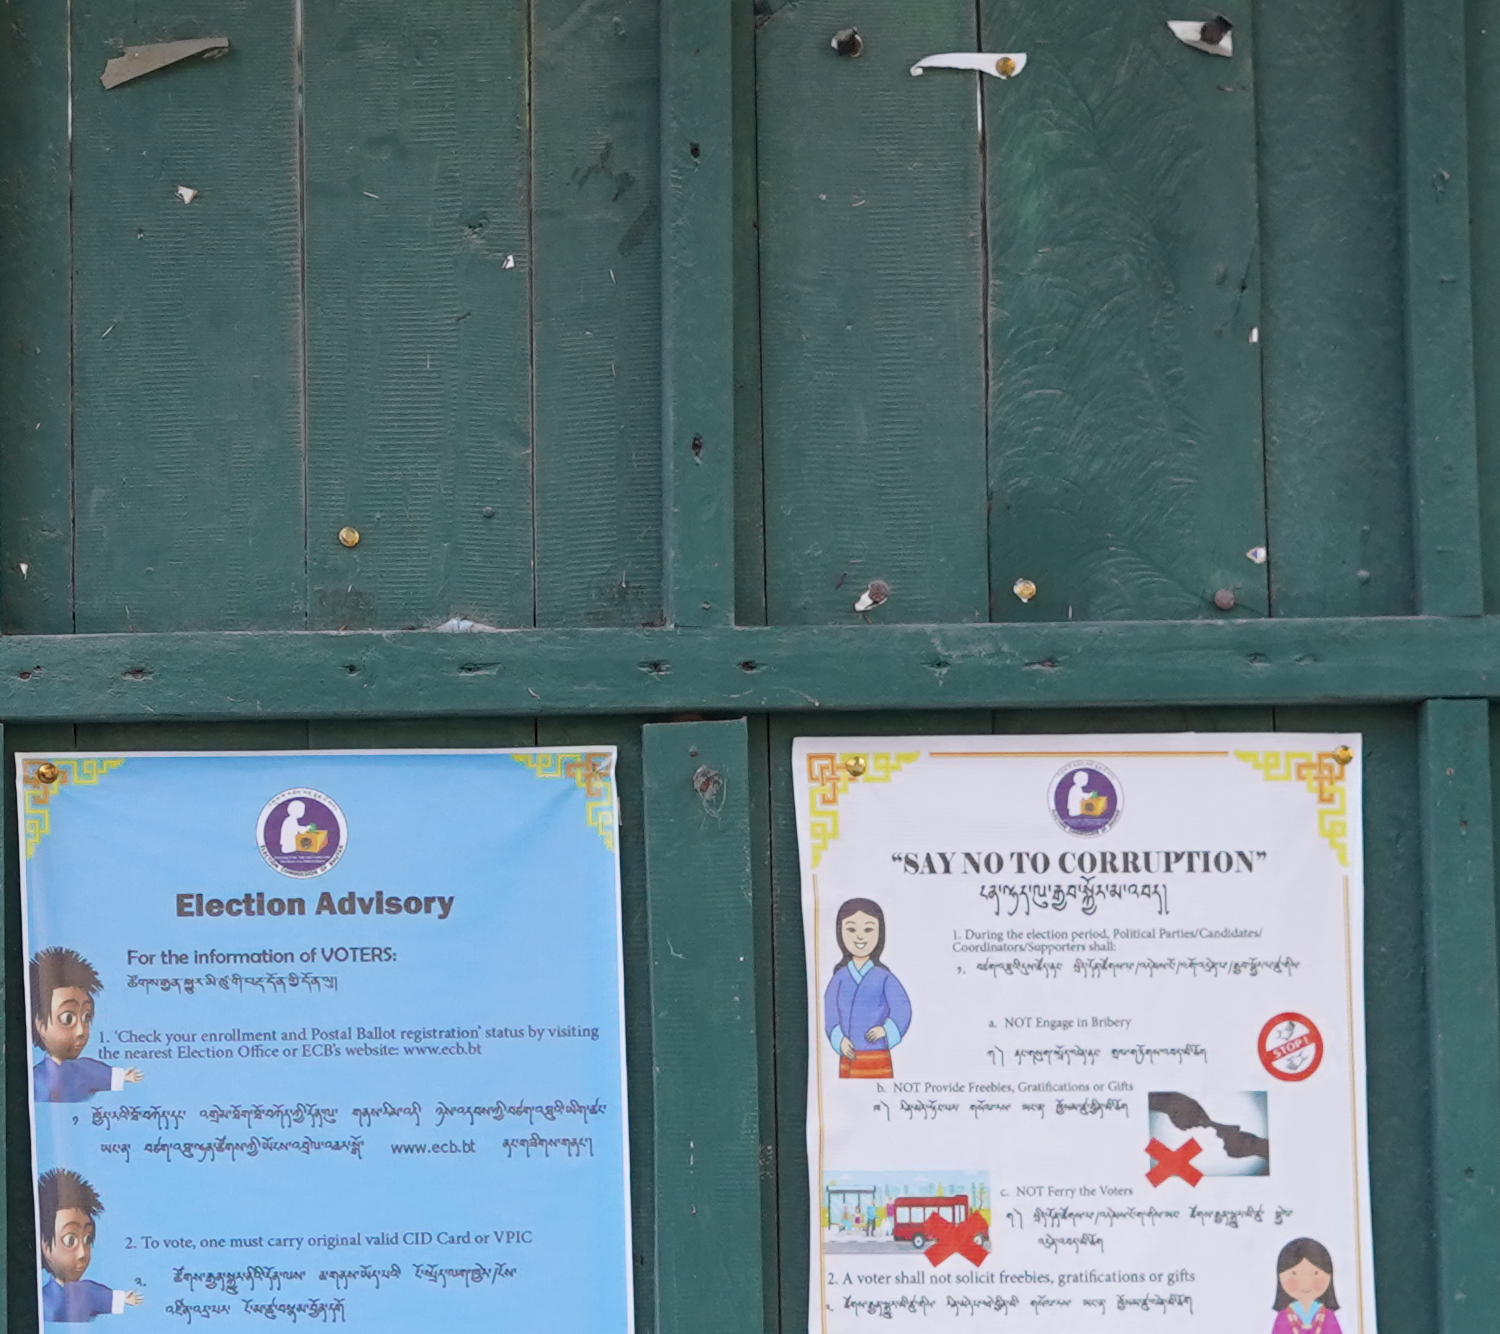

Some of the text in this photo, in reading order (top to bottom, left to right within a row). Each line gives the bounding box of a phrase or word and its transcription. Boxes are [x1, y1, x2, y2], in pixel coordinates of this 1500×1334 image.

[962, 851, 1004, 874] NO
[1009, 851, 1050, 874] TO
[175, 891, 455, 920] Election Advisory
[126, 945, 397, 965] For the information of VOTERS:
[1003, 1016, 1032, 1028] NOT
[1035, 1016, 1074, 1031] Engage
[1076, 1017, 1088, 1028] in
[1090, 1015, 1132, 1030] Bribery
[99, 1030, 110, 1043] 1.
[164, 1032, 197, 1046] your
[200, 1029, 277, 1041] enrollment
[280, 1027, 307, 1045] and
[310, 1026, 352, 1040] Postal
[356, 1025, 396, 1041] Ballot
[484, 1026, 525, 1039] status
[527, 1024, 545, 1042] by
[547, 1024, 599, 1041] visiting
[98, 1045, 120, 1062] the
[123, 1045, 172, 1059] nearest
[176, 1044, 233, 1059] Election
[236, 1043, 279, 1058] Office
[281, 1047, 298, 1058] or
[344, 1042, 399, 1056] website:
[402, 1042, 482, 1056] www.ecb.bt
[390, 1138, 476, 1154] www.ecb.bt
[1015, 1185, 1044, 1197] NOT
[1046, 1185, 1076, 1199] Ferry
[1078, 1184, 1096, 1196] the
[1098, 1184, 1133, 1196] Voters
[124, 1230, 533, 1251] 2. To vote, one must carry original valid CID Card or VPIC
[826, 1268, 1195, 1287] 2. A voter shall not solicit freebies, gratifications or gifts
